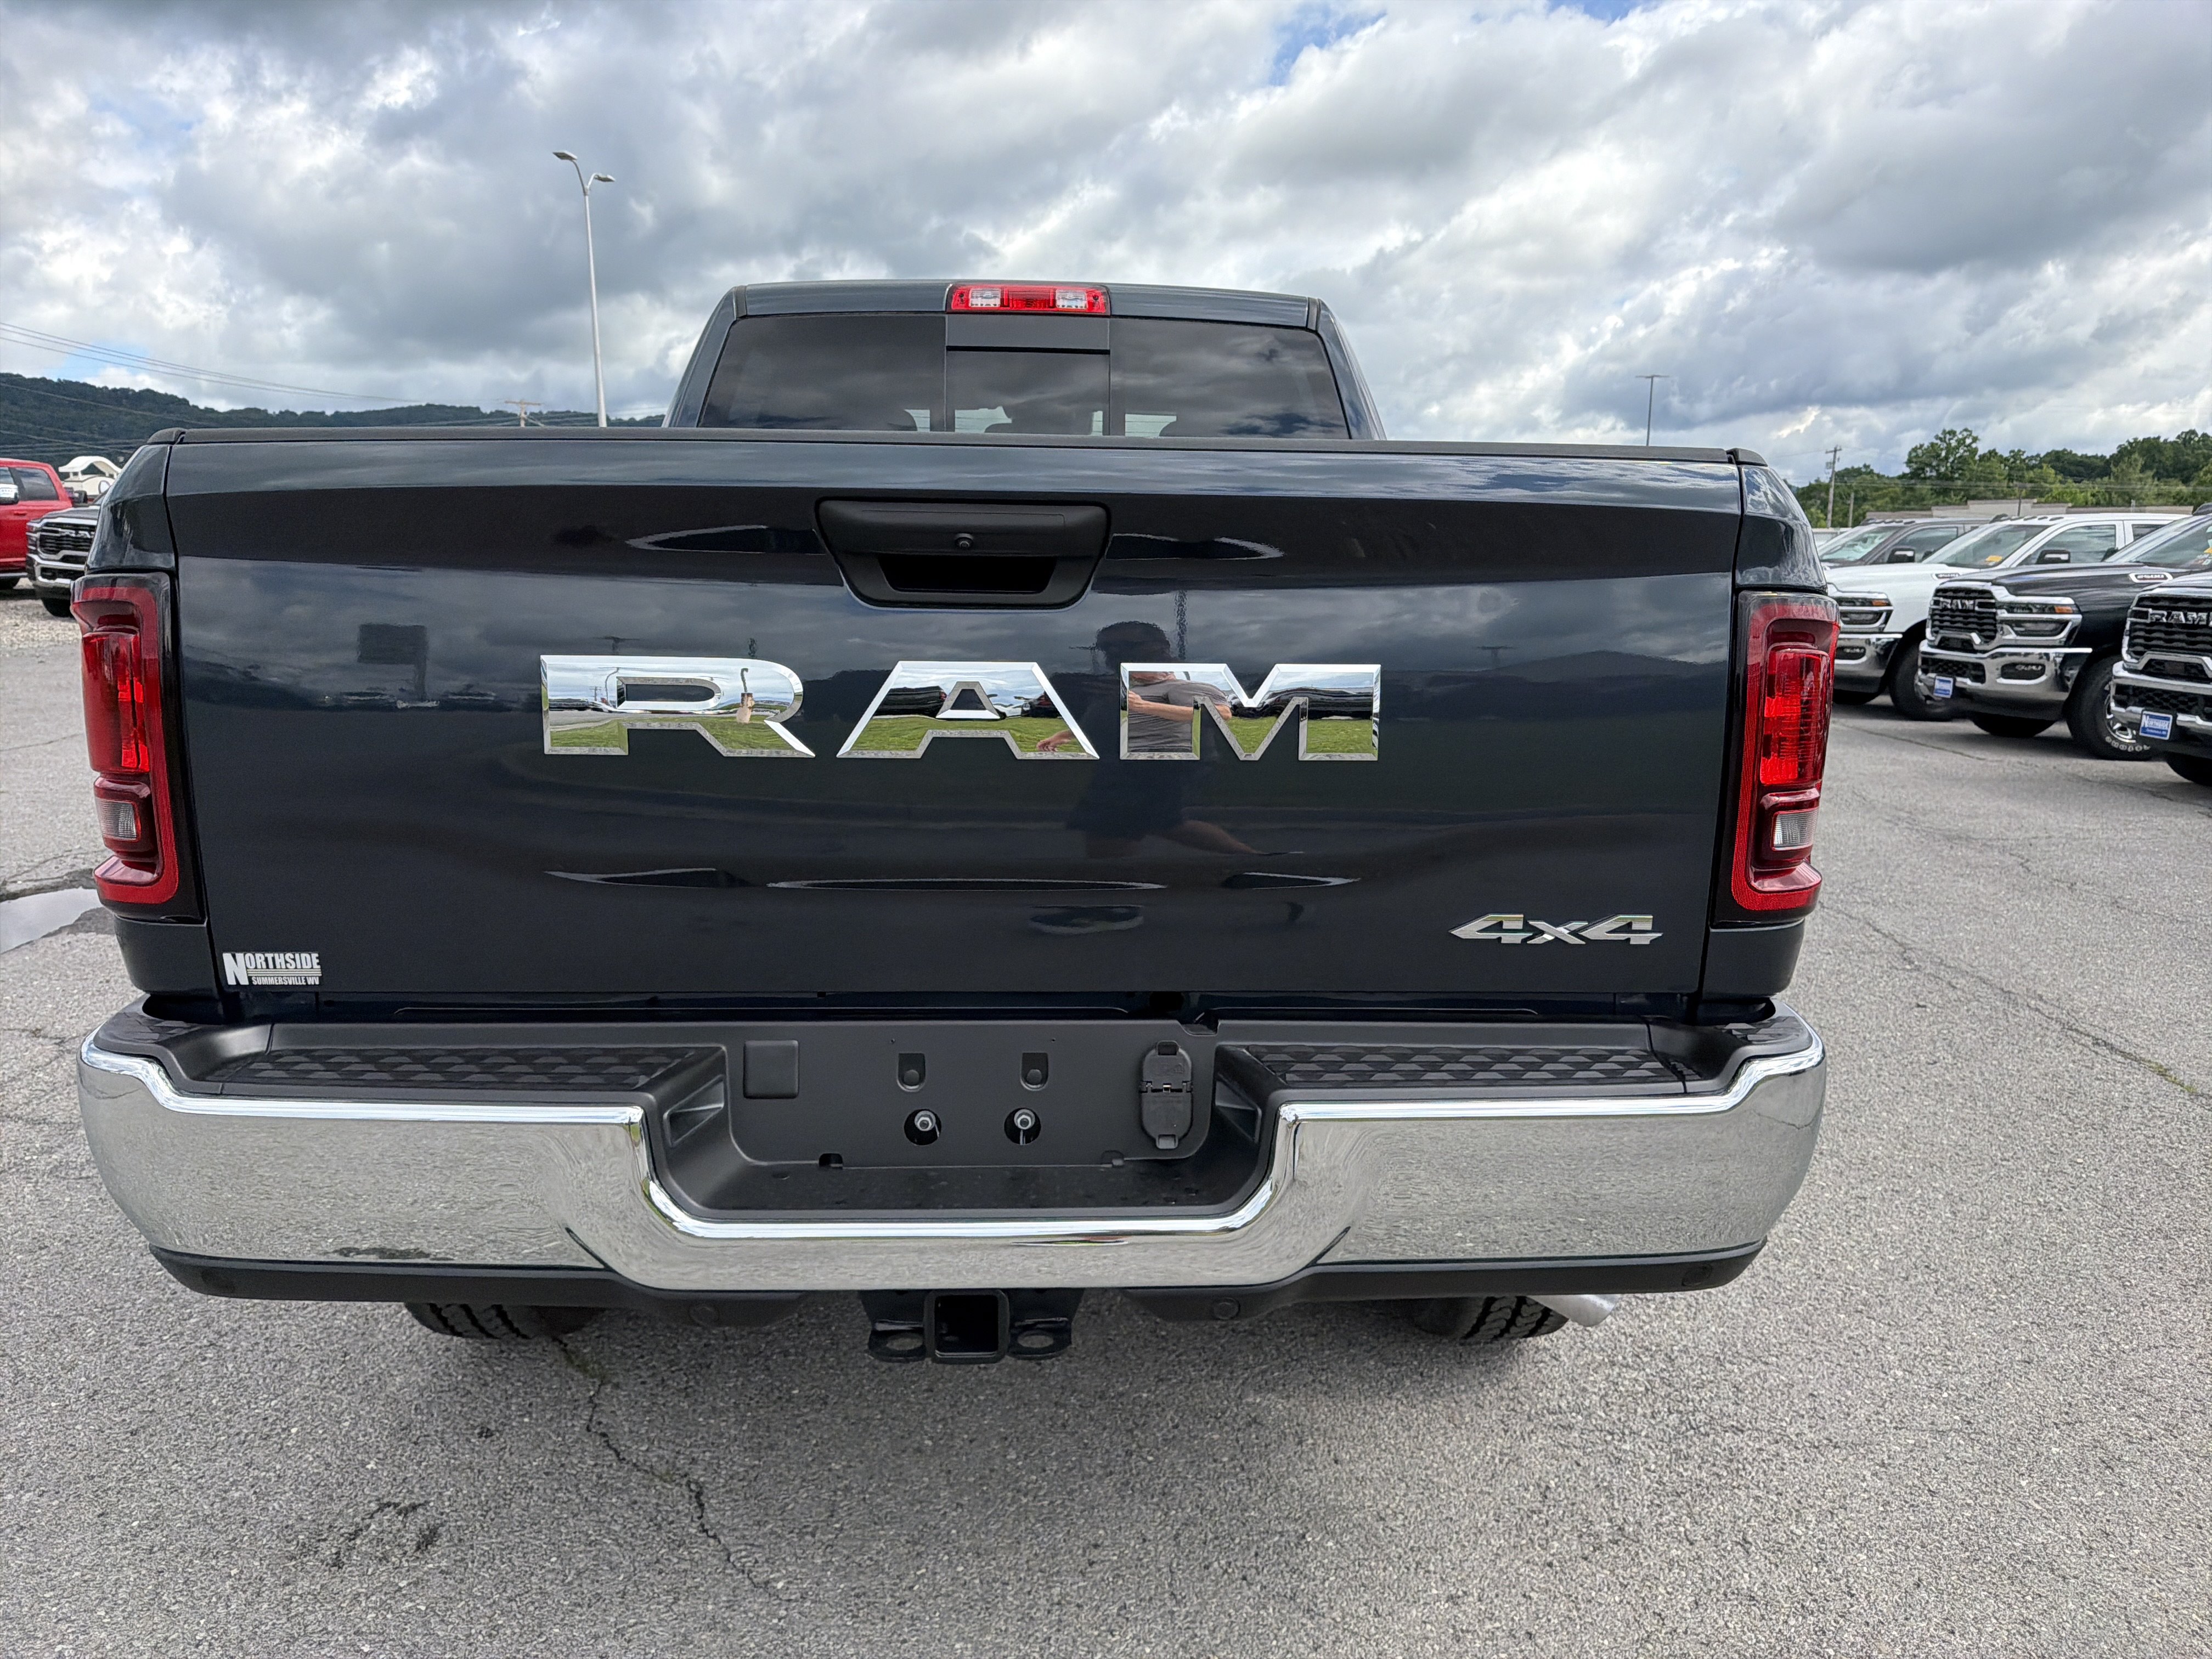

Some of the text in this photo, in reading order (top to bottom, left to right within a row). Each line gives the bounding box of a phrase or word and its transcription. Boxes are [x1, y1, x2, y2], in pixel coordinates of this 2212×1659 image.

[2150, 609, 2208, 625] RAM
[540, 656, 1381, 761] RAM
[1449, 913, 1663, 944] 4x4
[222, 953, 321, 985] NORTHSIDE
[252, 977, 319, 985] SUMMERSVILLE WV
